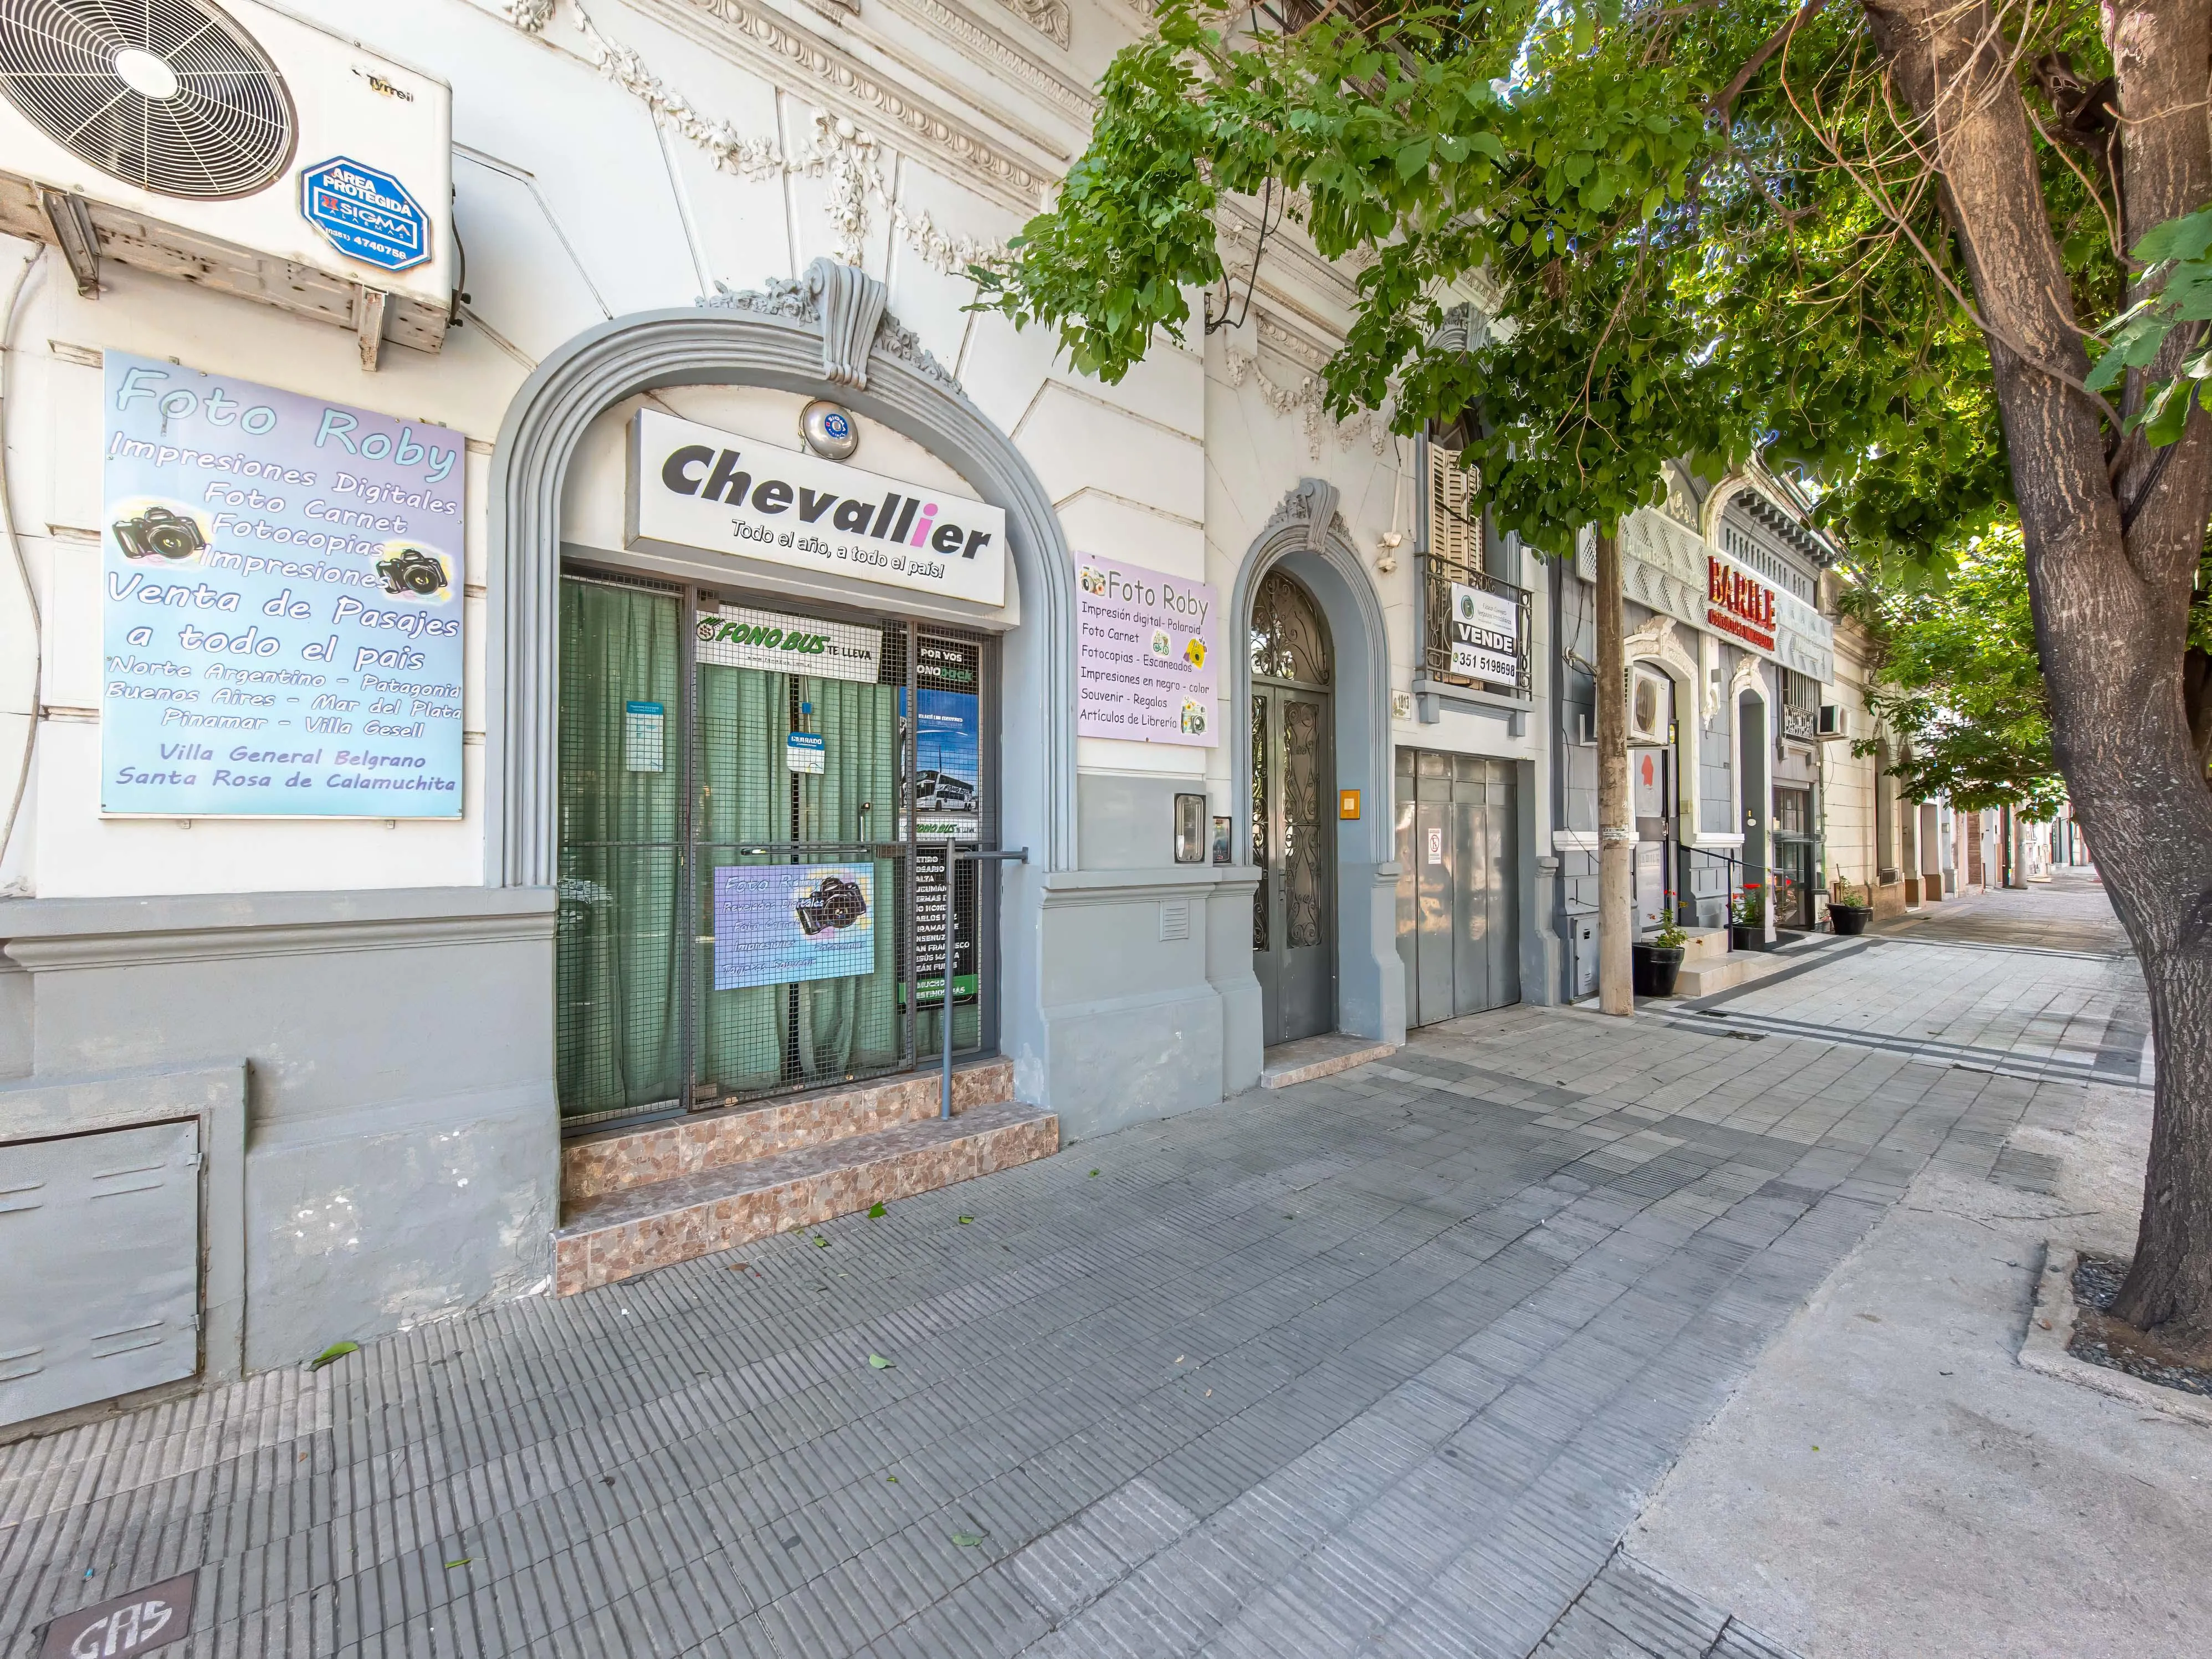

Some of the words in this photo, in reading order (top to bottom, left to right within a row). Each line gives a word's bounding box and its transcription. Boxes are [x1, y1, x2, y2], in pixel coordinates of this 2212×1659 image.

[323, 174, 412, 217] PROTEGIDA
[332, 168, 376, 193] AREA
[340, 203, 411, 237] SIGMA
[117, 367, 277, 435] Foto
[315, 407, 457, 483] Roby
[109, 431, 316, 487] Impresiones
[332, 472, 457, 515] Digitales
[204, 482, 286, 514] Foto
[304, 500, 408, 534] Carnet
[662, 445, 992, 560] Chevallier
[212, 513, 385, 557] Fotocopias
[732, 519, 774, 544] Todo
[778, 531, 795, 548] el
[797, 536, 831, 559] año,
[837, 546, 847, 559] a
[852, 546, 887, 567] todo
[890, 555, 906, 571] el
[908, 560, 945, 579] país!
[198, 545, 392, 591] Impresiones
[108, 572, 240, 612] Venta
[262, 589, 311, 619] de
[332, 596, 460, 639] Pasajes
[1109, 571, 1155, 606] Foto
[1163, 583, 1209, 626] Roby
[1082, 601, 1130, 622] Impresión
[1168, 618, 1201, 635] Polaroid
[1082, 623, 1105, 637] Foto
[1108, 628, 1139, 643] Carnet
[126, 625, 153, 647] a
[180, 624, 281, 657] todo
[301, 634, 339, 662] el
[354, 645, 426, 672] pais
[842, 648, 872, 660] LLEVA
[1458, 623, 1513, 653] VENDE
[1082, 644, 1133, 664] Fotocopias
[1143, 654, 1192, 672] Escaneados
[1460, 653, 1477, 668] 351
[1480, 657, 1515, 677] 5198698
[108, 656, 192, 678] Norte
[205, 663, 326, 688] Argentino
[360, 674, 460, 699] Patagonia
[1081, 666, 1140, 685] Impresiones
[1143, 677, 1153, 687] en
[1156, 680, 1180, 692] negro
[1189, 682, 1210, 694] color
[105, 682, 198, 703] Buenos
[212, 688, 275, 707] Aires
[311, 694, 360, 713] Mar
[368, 698, 401, 715] del
[410, 700, 462, 720] Plata
[1081, 688, 1124, 703] Souvenir
[1134, 694, 1168, 709] Regalos
[161, 708, 269, 731] Pinamar
[305, 716, 352, 735] Villa
[363, 719, 426, 739] Gesell
[1080, 709, 1125, 724] Artículos
[1128, 713, 1139, 725] de
[1142, 714, 1177, 728] Librería
[160, 743, 214, 761] Villa
[229, 746, 322, 765] General
[334, 751, 427, 770] Belgrano
[115, 766, 197, 786] Santa
[213, 769, 270, 788] Rosa
[285, 771, 313, 789] de
[326, 774, 456, 792] Calamuchita
[71, 1601, 172, 1659] GAS
